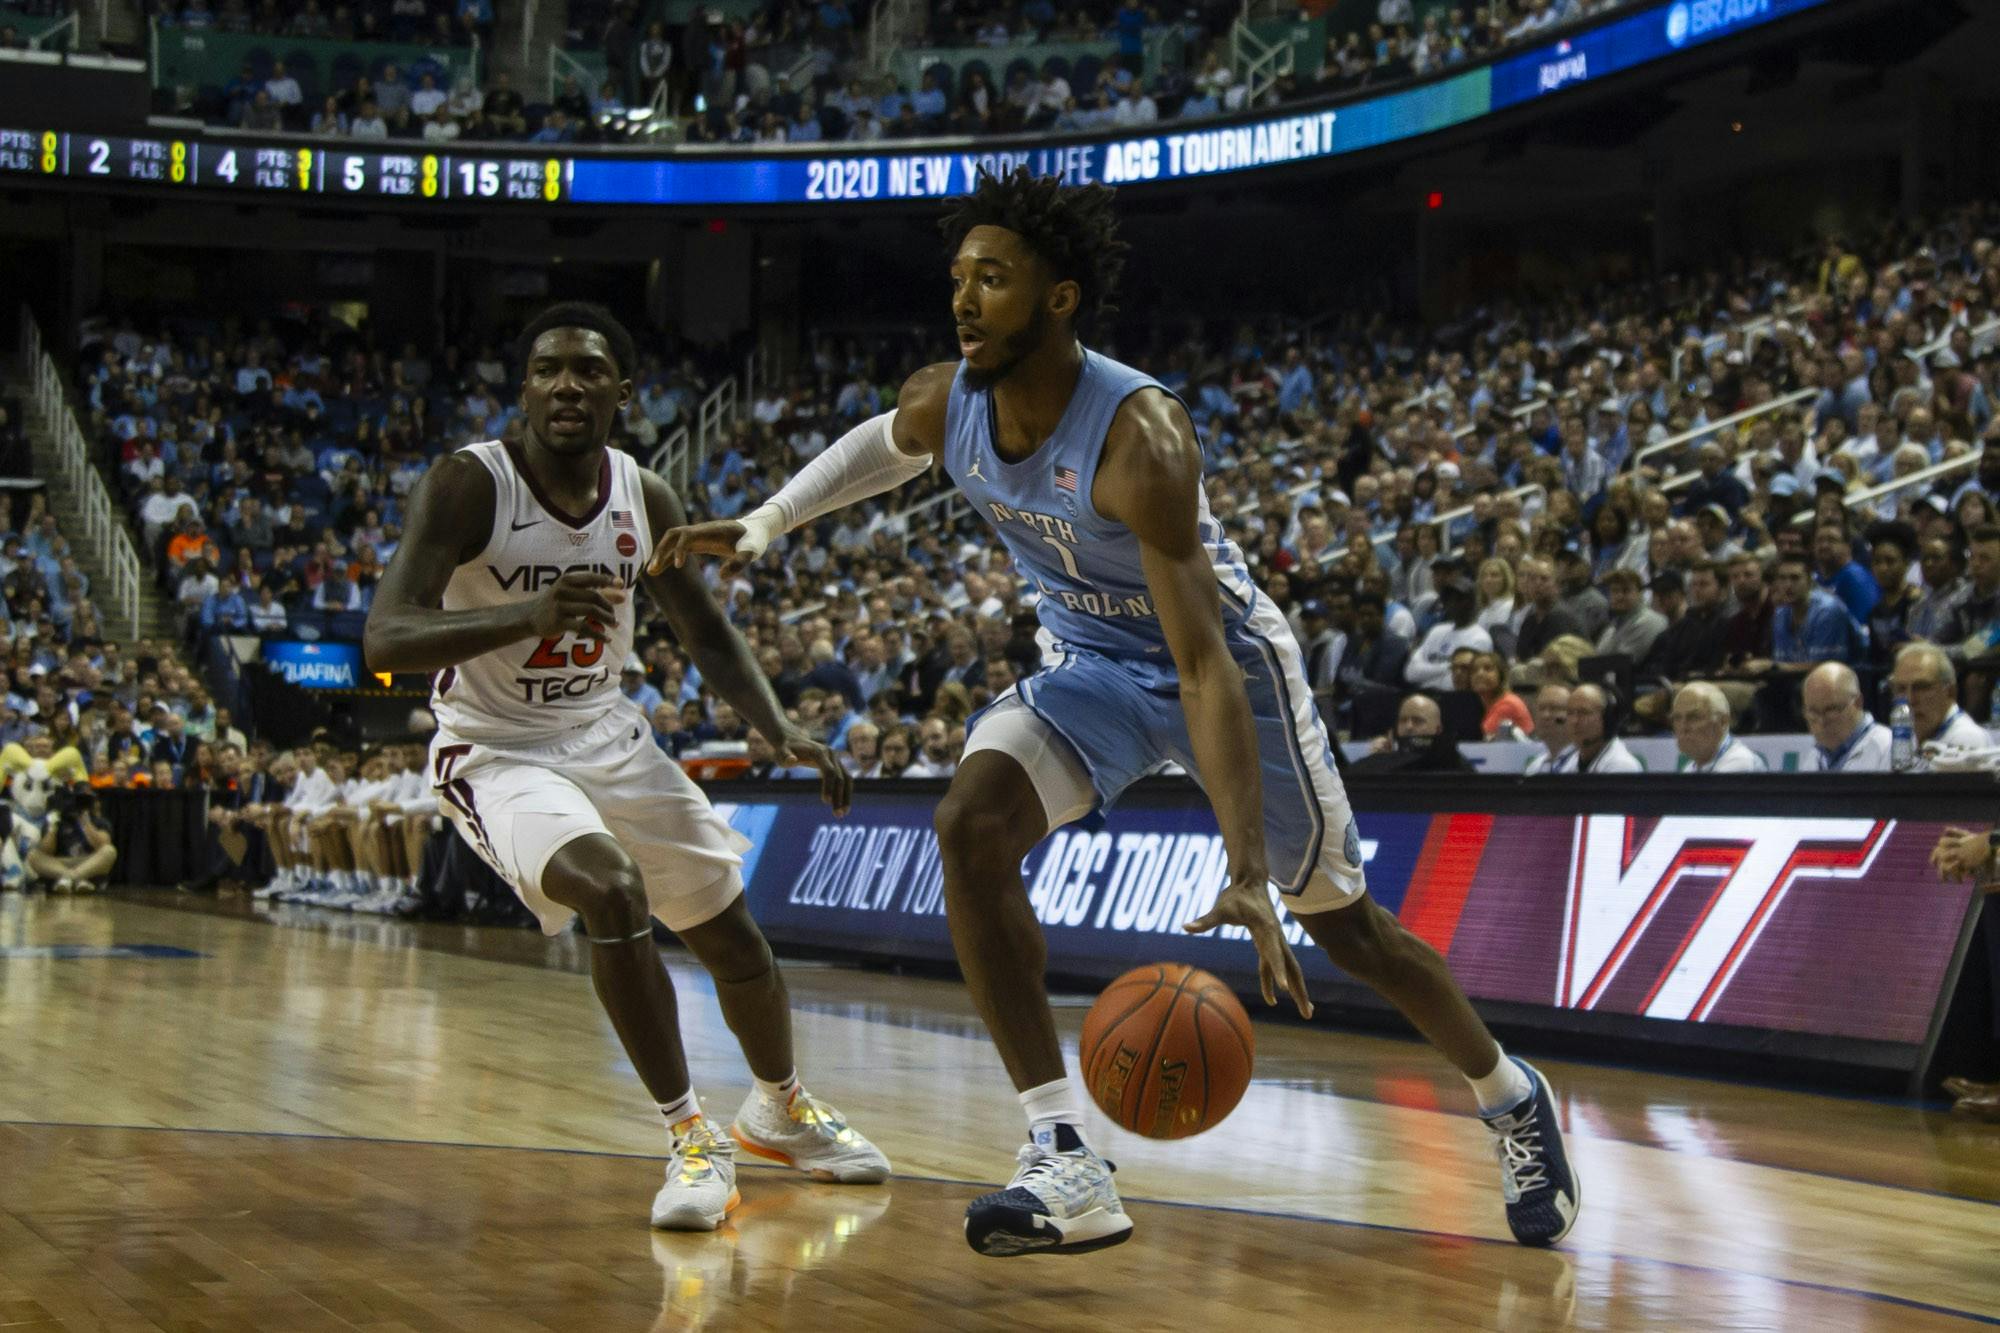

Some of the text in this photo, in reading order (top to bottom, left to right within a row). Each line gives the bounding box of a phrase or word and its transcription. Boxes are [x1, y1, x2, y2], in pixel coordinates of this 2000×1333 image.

[42, 131, 57, 152] 0
[89, 140, 110, 174] 2
[170, 141, 186, 161] 0
[806, 159, 879, 200] 2020
[888, 155, 952, 197] NEW
[1103, 140, 1160, 184] ACC
[1167, 112, 1337, 175] TOURNAMENT
[41, 153, 56, 173] 0
[170, 161, 185, 183] 0
[216, 150, 239, 183] 4
[297, 148, 312, 170] 3
[343, 156, 364, 191] 5
[422, 155, 438, 176] 0
[545, 159, 560, 180] 0
[299, 170, 310, 191] 1
[422, 176, 437, 197] 0
[459, 161, 500, 196] 15
[544, 180, 559, 201] 0
[988, 503, 1079, 544] NRTH
[1041, 535, 1095, 586] 1
[488, 563, 644, 592] VIRNI
[515, 665, 609, 703] TECH
[789, 824, 946, 916] 2020 NEW YO
[1030, 831, 1113, 927] ACC
[1555, 814, 1896, 1021] VT
